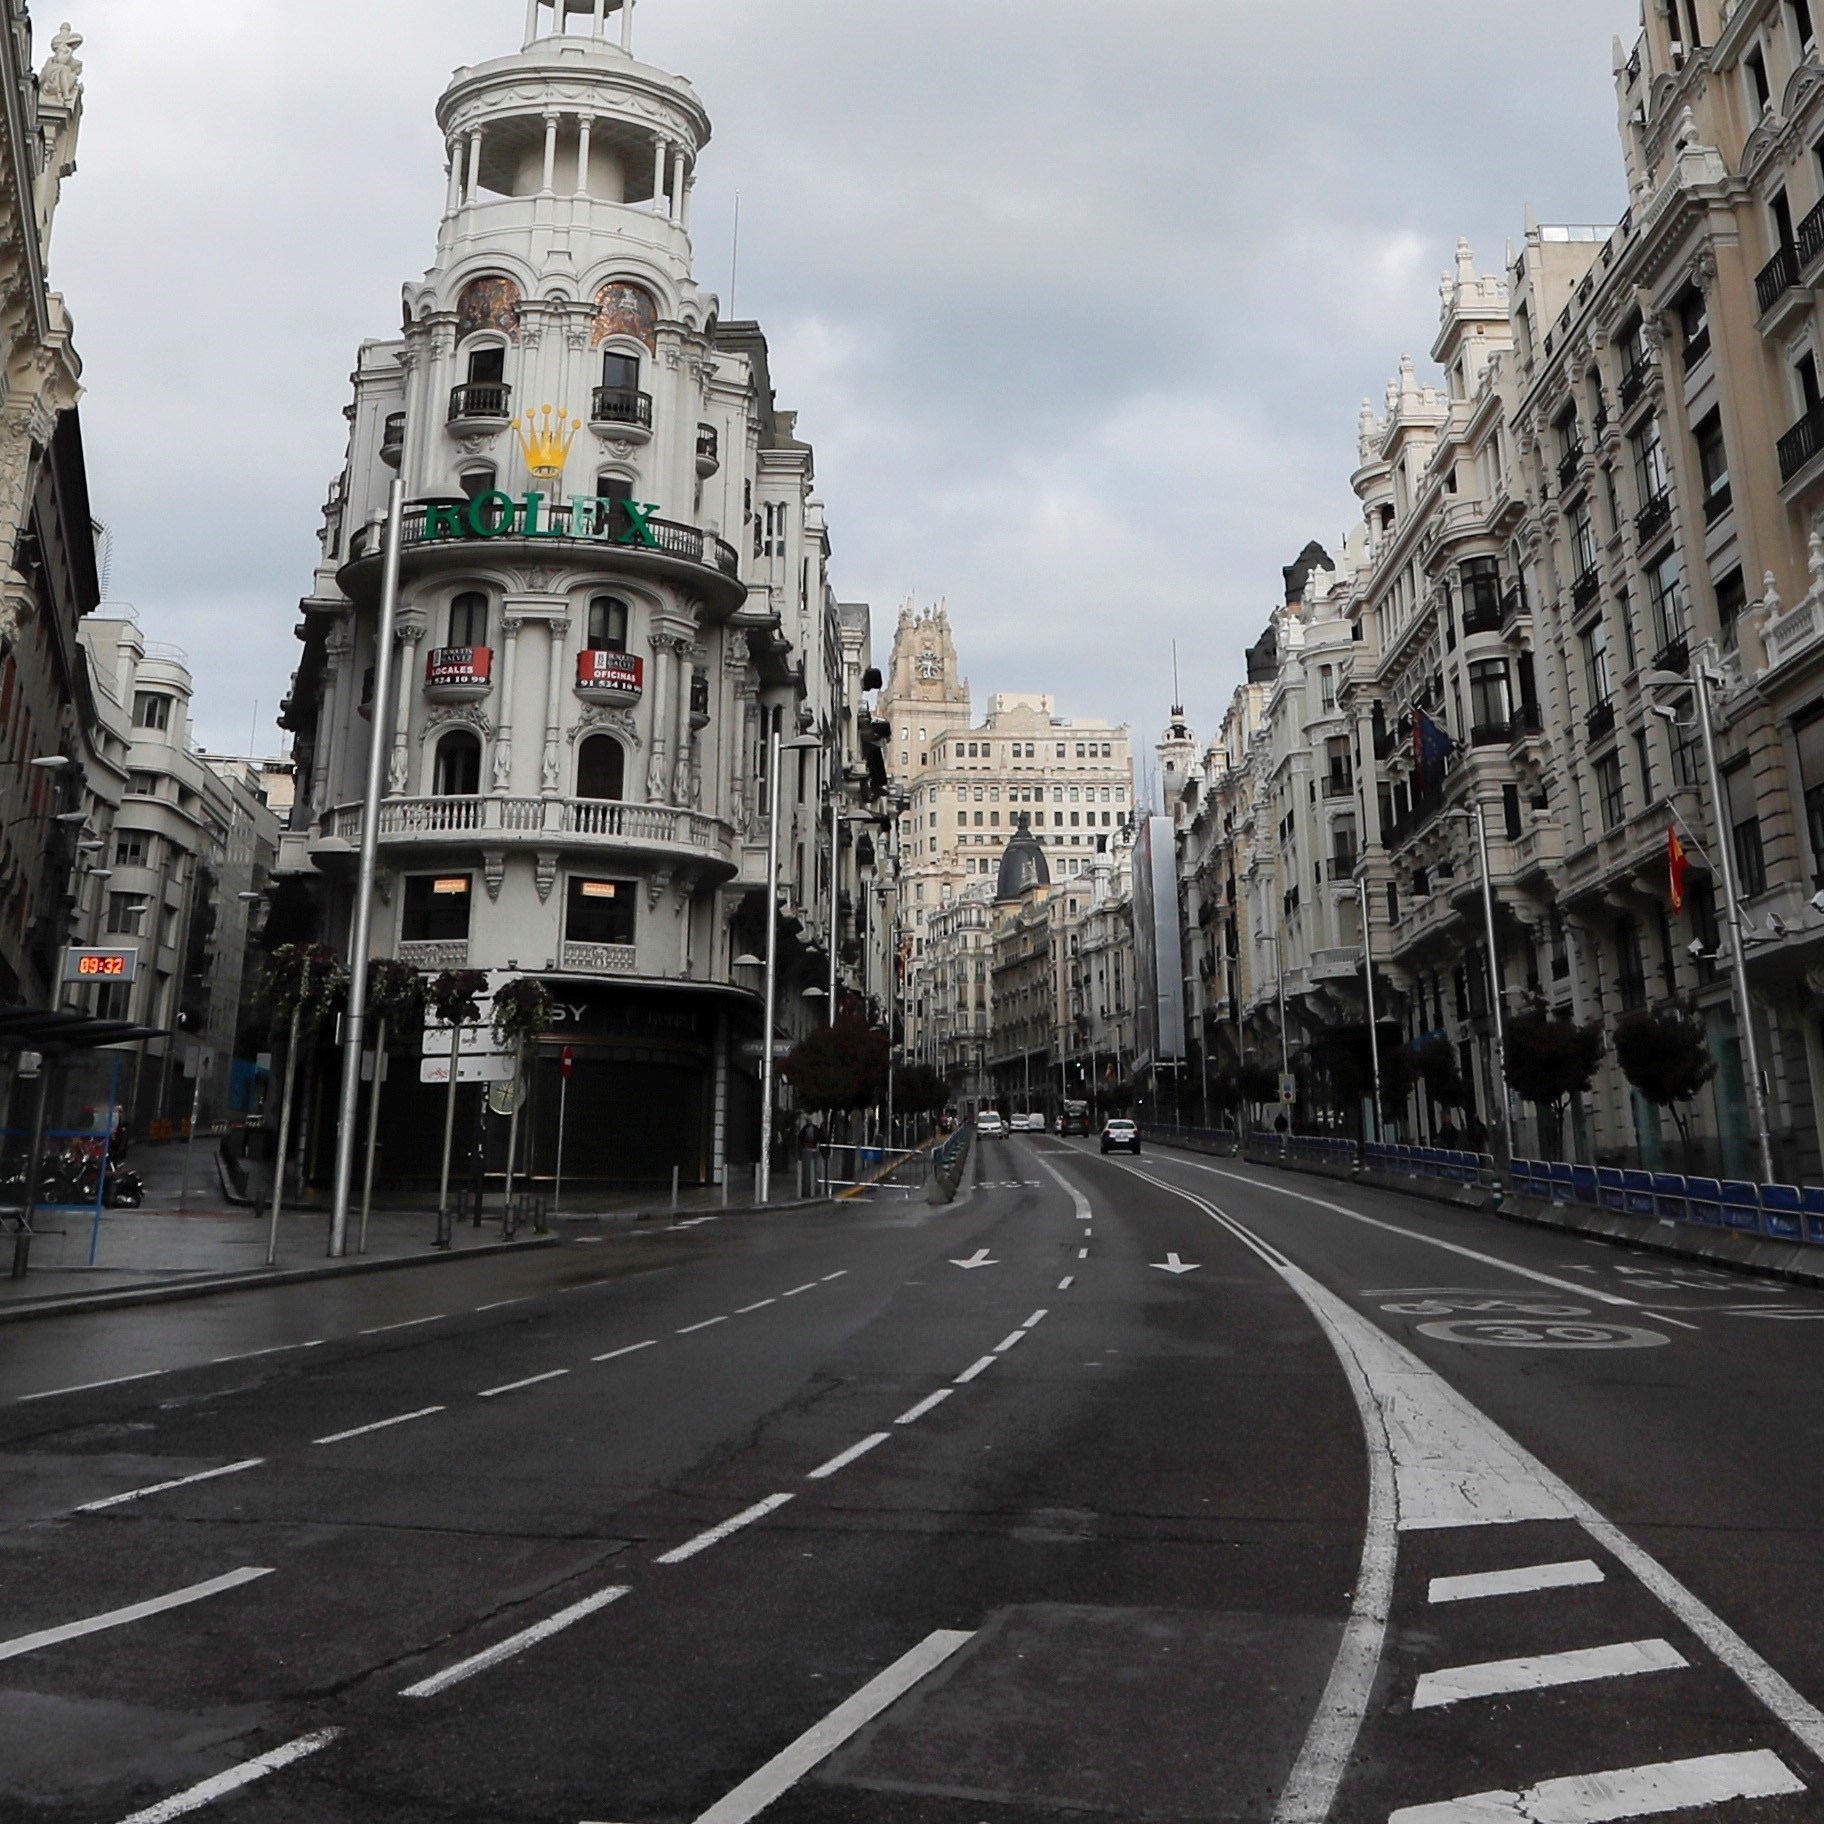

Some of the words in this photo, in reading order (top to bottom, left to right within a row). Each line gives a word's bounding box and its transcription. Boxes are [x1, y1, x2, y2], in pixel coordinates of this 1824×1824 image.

[421, 490, 663, 549] ROLEX
[431, 665, 474, 676] LOCALES
[594, 670, 636, 683] OFICINAS
[470, 676, 485, 684] 99
[580, 679, 594, 687] 91
[598, 679, 619, 688] 524
[79, 957, 123, 974] 09:32
[1476, 1327, 1614, 1343] 30
